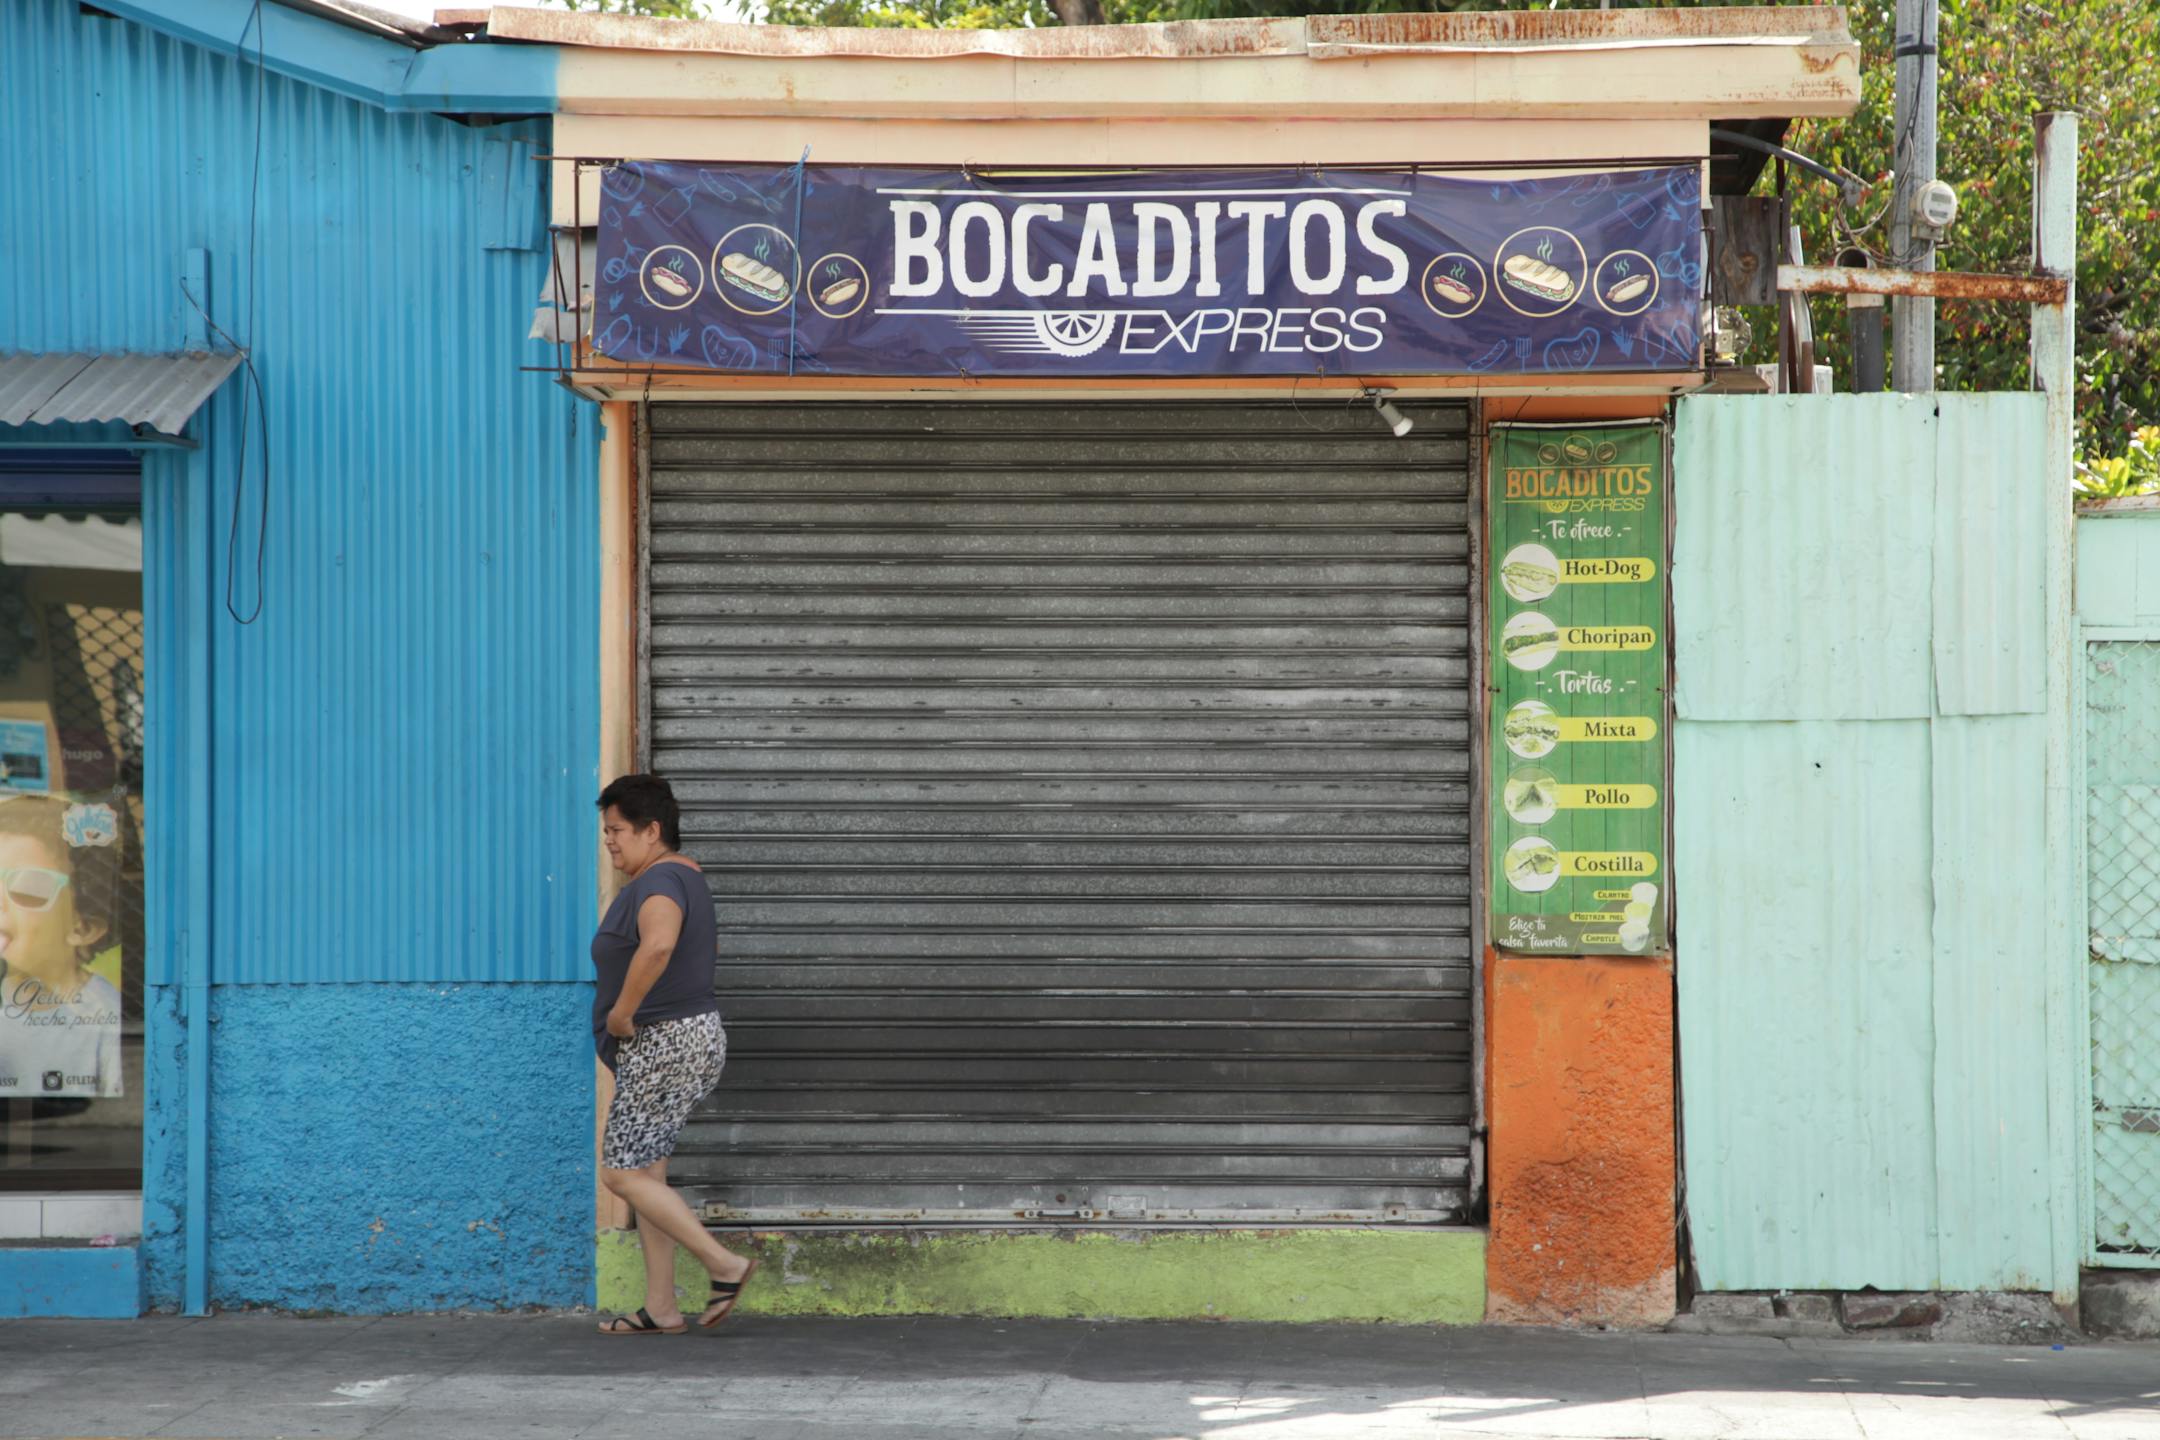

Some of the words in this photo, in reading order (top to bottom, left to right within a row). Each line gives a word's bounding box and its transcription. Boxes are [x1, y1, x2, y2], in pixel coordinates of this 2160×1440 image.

[889, 199, 1410, 297] BOCADITOS
[1119, 307, 1387, 354] EXPRESS
[1505, 466, 1652, 498] BOCADITOS
[1569, 497, 1646, 513] EXPRESS
[1546, 519, 1567, 539] Te
[1570, 518, 1613, 541] ofrece
[1565, 560, 1641, 581] Hot-Dog
[1567, 628, 1651, 649] Choripan
[1552, 670, 1612, 694] Tortas
[1584, 721, 1637, 737] Mixta
[63, 748, 104, 762] hugo
[1584, 788, 1631, 805] Pollo
[1574, 855, 1644, 872] Costilla
[1508, 915, 1534, 938] Elige
[1529, 933, 1568, 949] favorita
